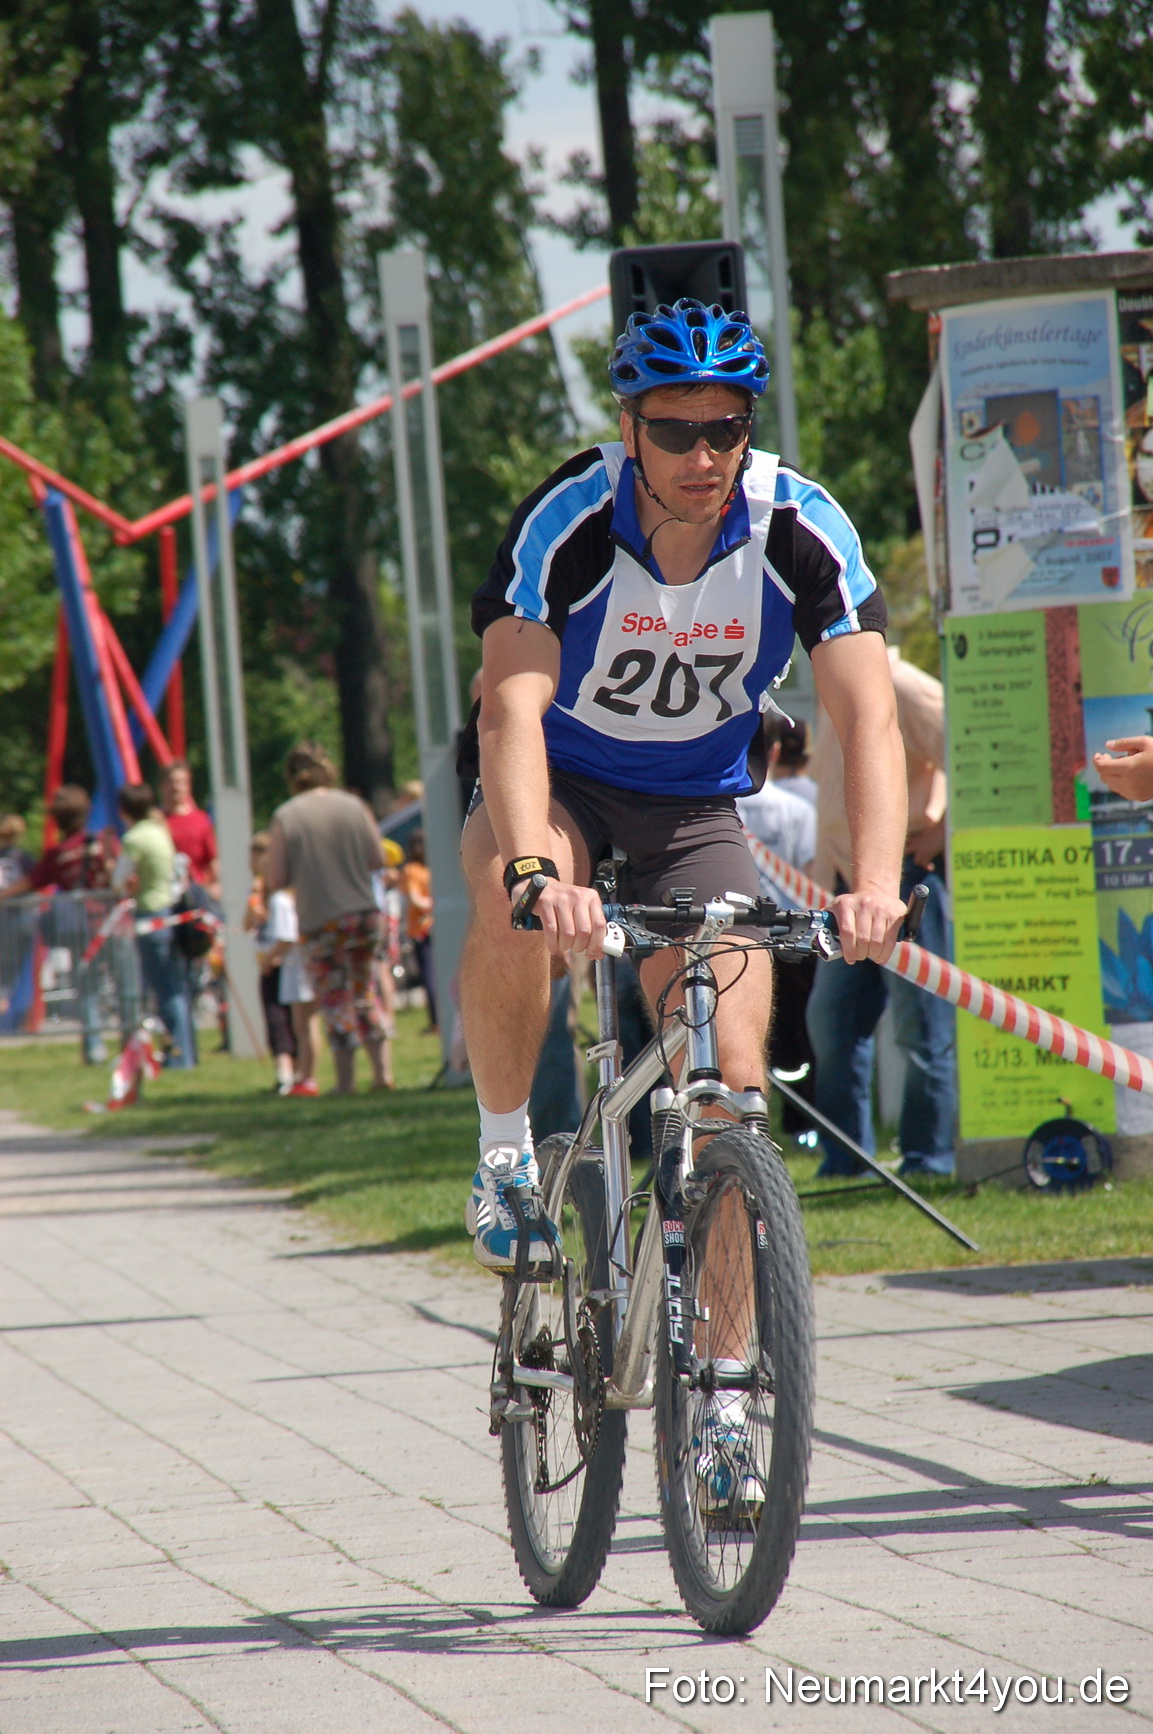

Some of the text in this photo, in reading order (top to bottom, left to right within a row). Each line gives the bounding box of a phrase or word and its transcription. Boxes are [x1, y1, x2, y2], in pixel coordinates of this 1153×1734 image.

[621, 612, 719, 647] Spaase
[593, 648, 744, 722] 207
[519, 860, 537, 872] 207
[664, 1221, 685, 1233] ROCK
